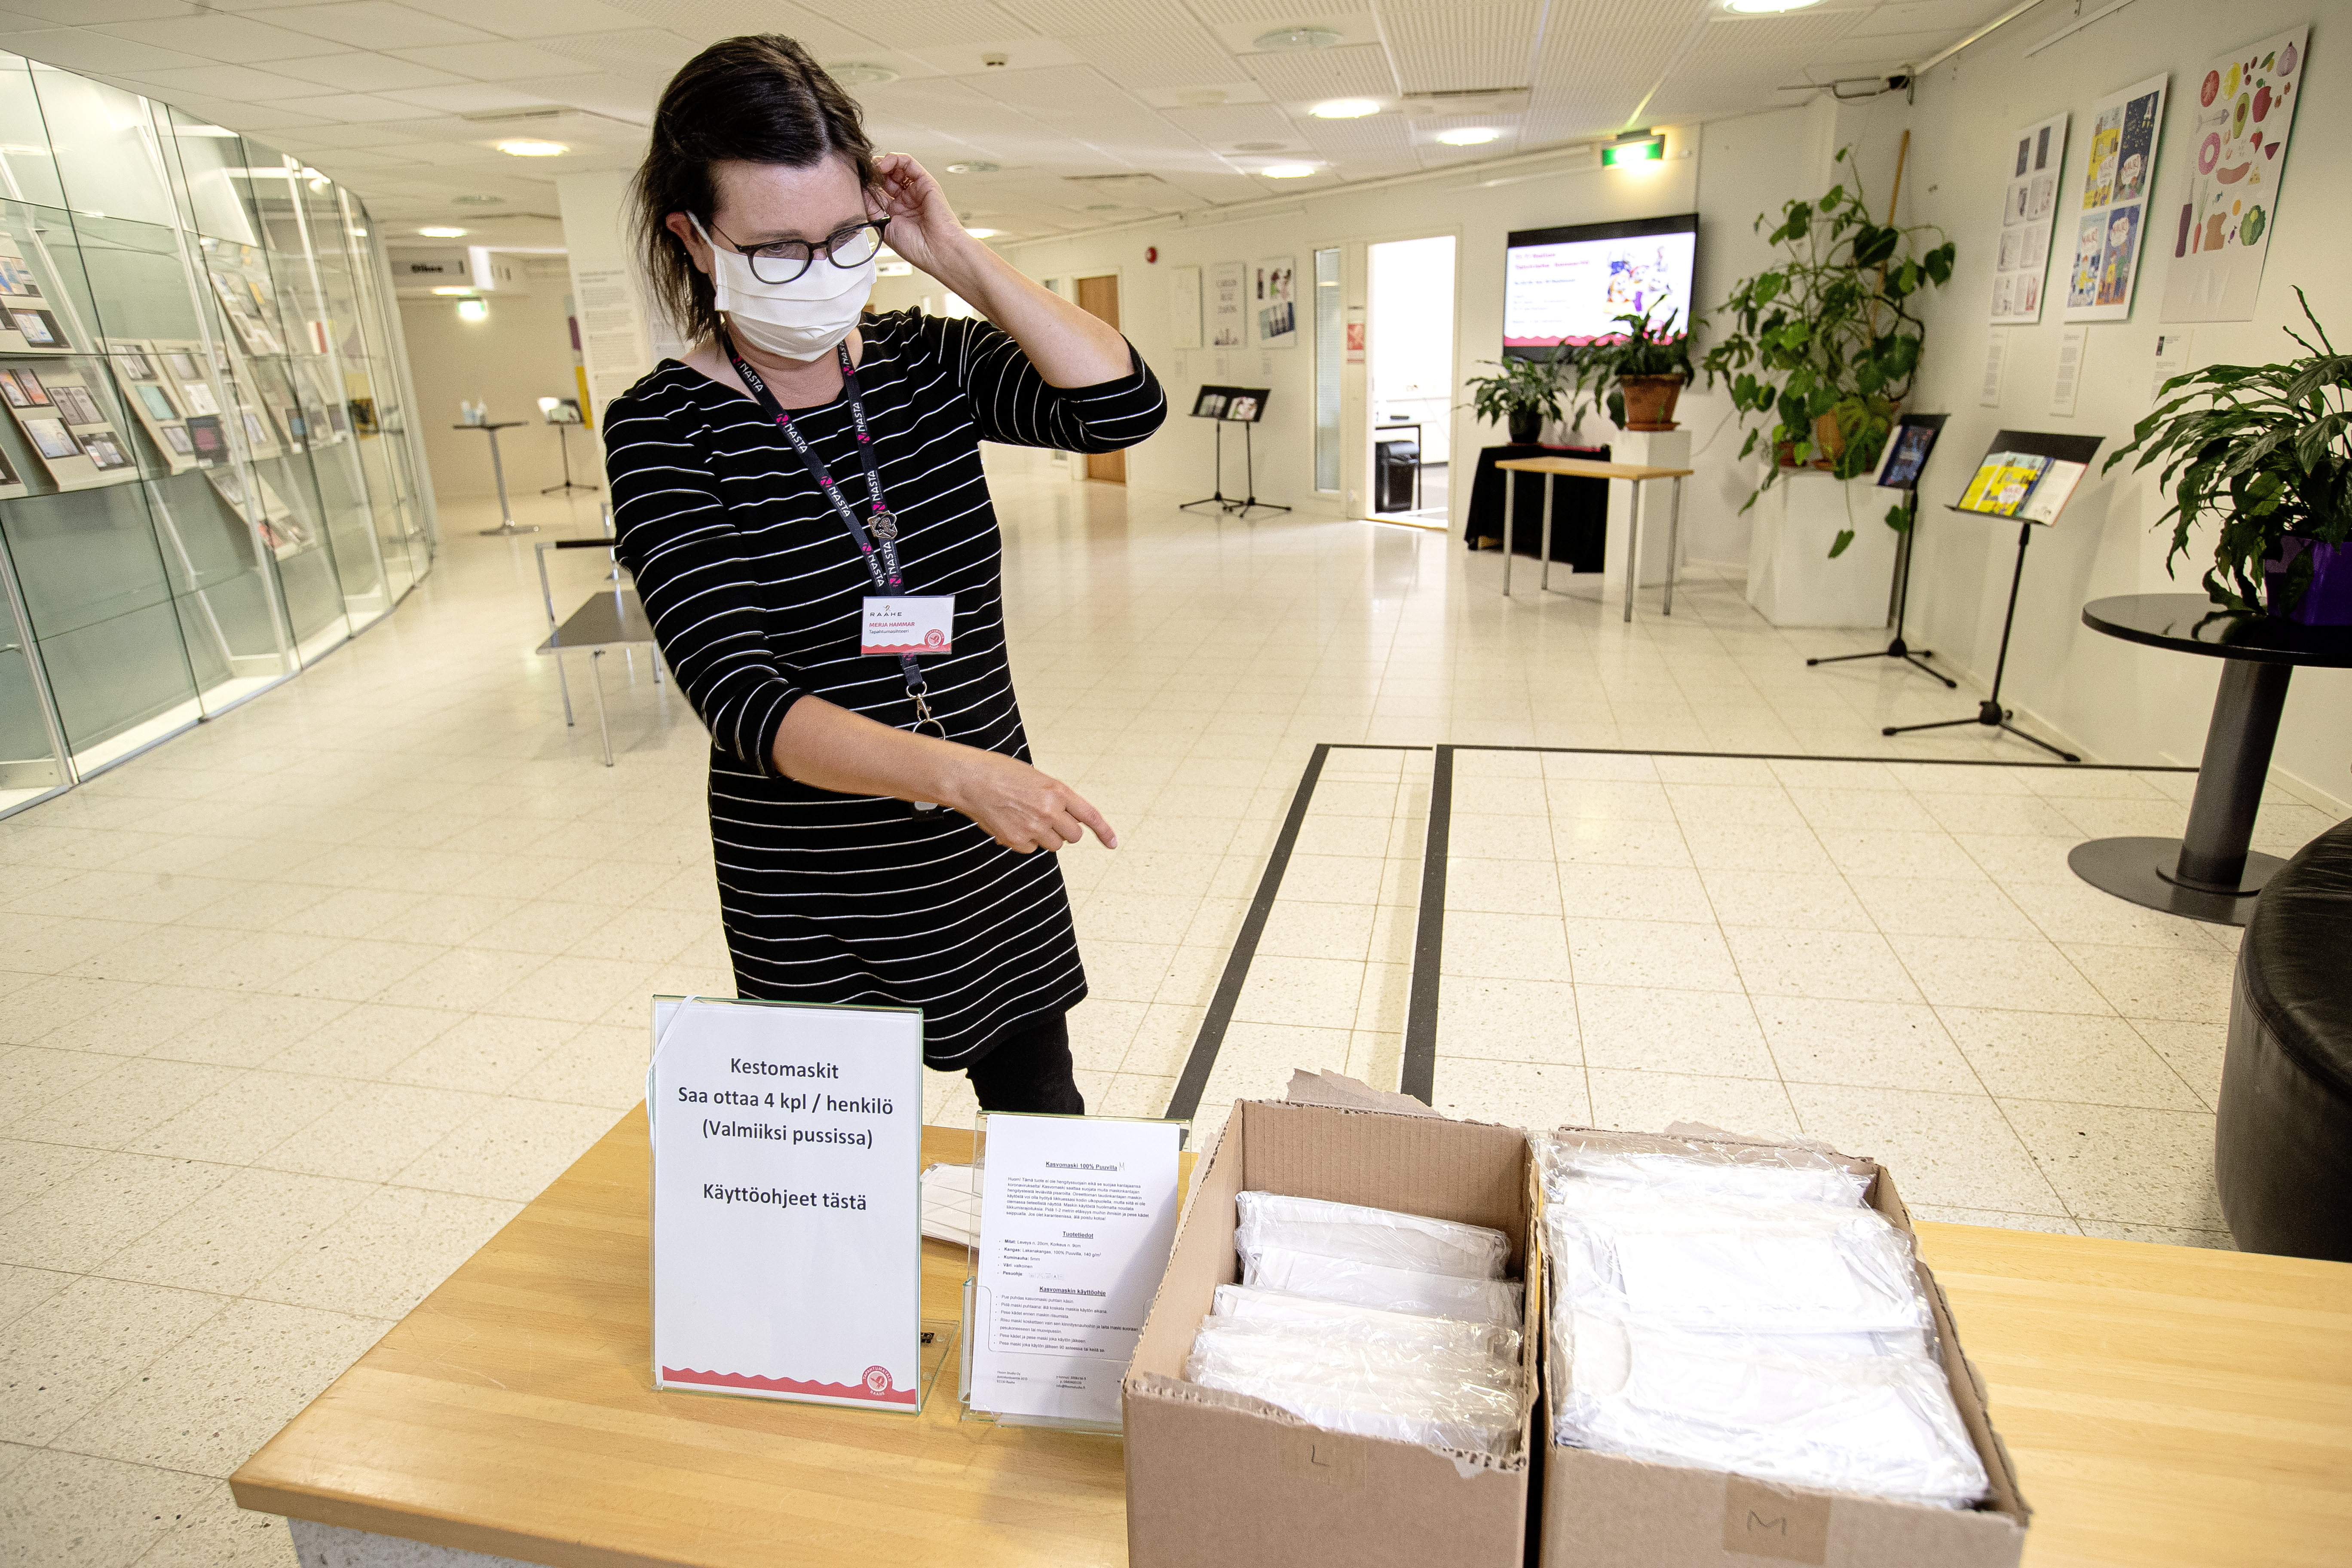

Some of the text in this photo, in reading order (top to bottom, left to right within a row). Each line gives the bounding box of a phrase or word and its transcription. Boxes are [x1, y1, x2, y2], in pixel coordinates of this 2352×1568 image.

[839, 341, 850, 364] NAST
[740, 363, 763, 392] NASTA
[854, 402, 866, 431] NASTA
[785, 423, 808, 453] NASTA
[868, 470, 881, 501] NASTA
[829, 487, 850, 517] NASTA
[868, 554, 885, 587] NASTA
[883, 541, 897, 574] NASTA
[731, 1058, 839, 1079] Kestomaskit
[679, 1087, 893, 1115] Saa ottaa 4 kpl / henkilö
[703, 1119, 872, 1149] (Valmiiksi pussissa)
[1119, 1162, 1125, 1171] M
[704, 1184, 866, 1210] Käyttöohjeet tästä
[863, 1366, 891, 1382] TAPAHTUMATALO
[1311, 1445, 1330, 1467] L
[1746, 1510, 1786, 1535] M
